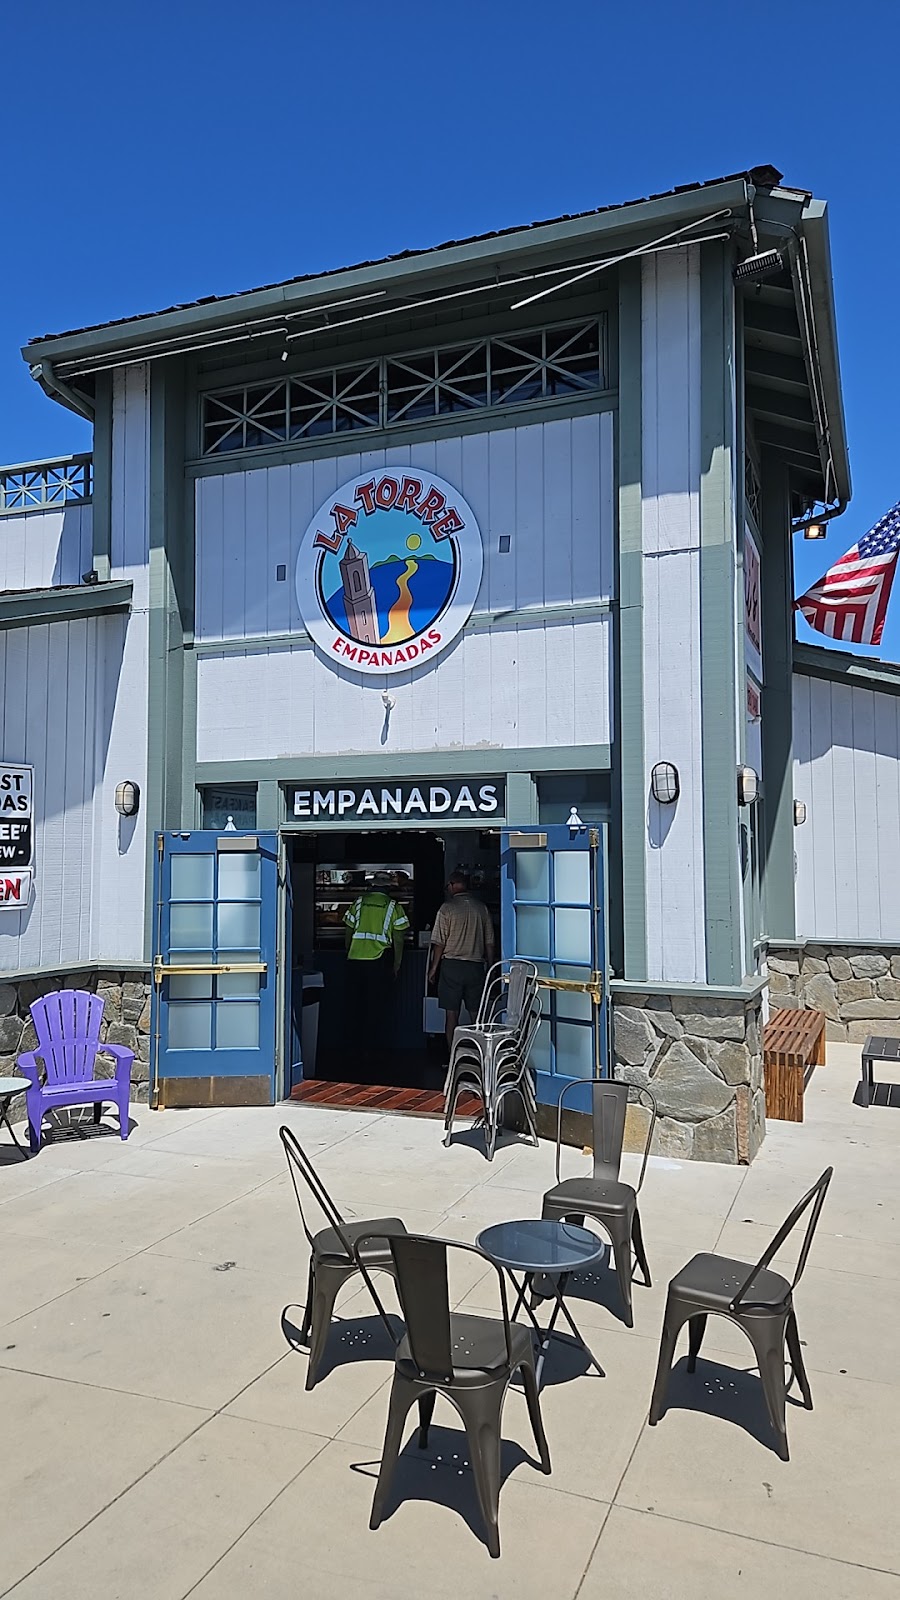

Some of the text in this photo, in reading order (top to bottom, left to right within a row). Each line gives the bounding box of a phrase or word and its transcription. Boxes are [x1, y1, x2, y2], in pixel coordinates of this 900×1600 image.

[313, 475, 465, 554] LA TORRE
[331, 629, 442, 666] EMPANADAS
[0, 794, 28, 811] AS
[293, 785, 498, 816] EMPANADAS
[0, 845, 16, 858] W
[0, 878, 21, 900] N
